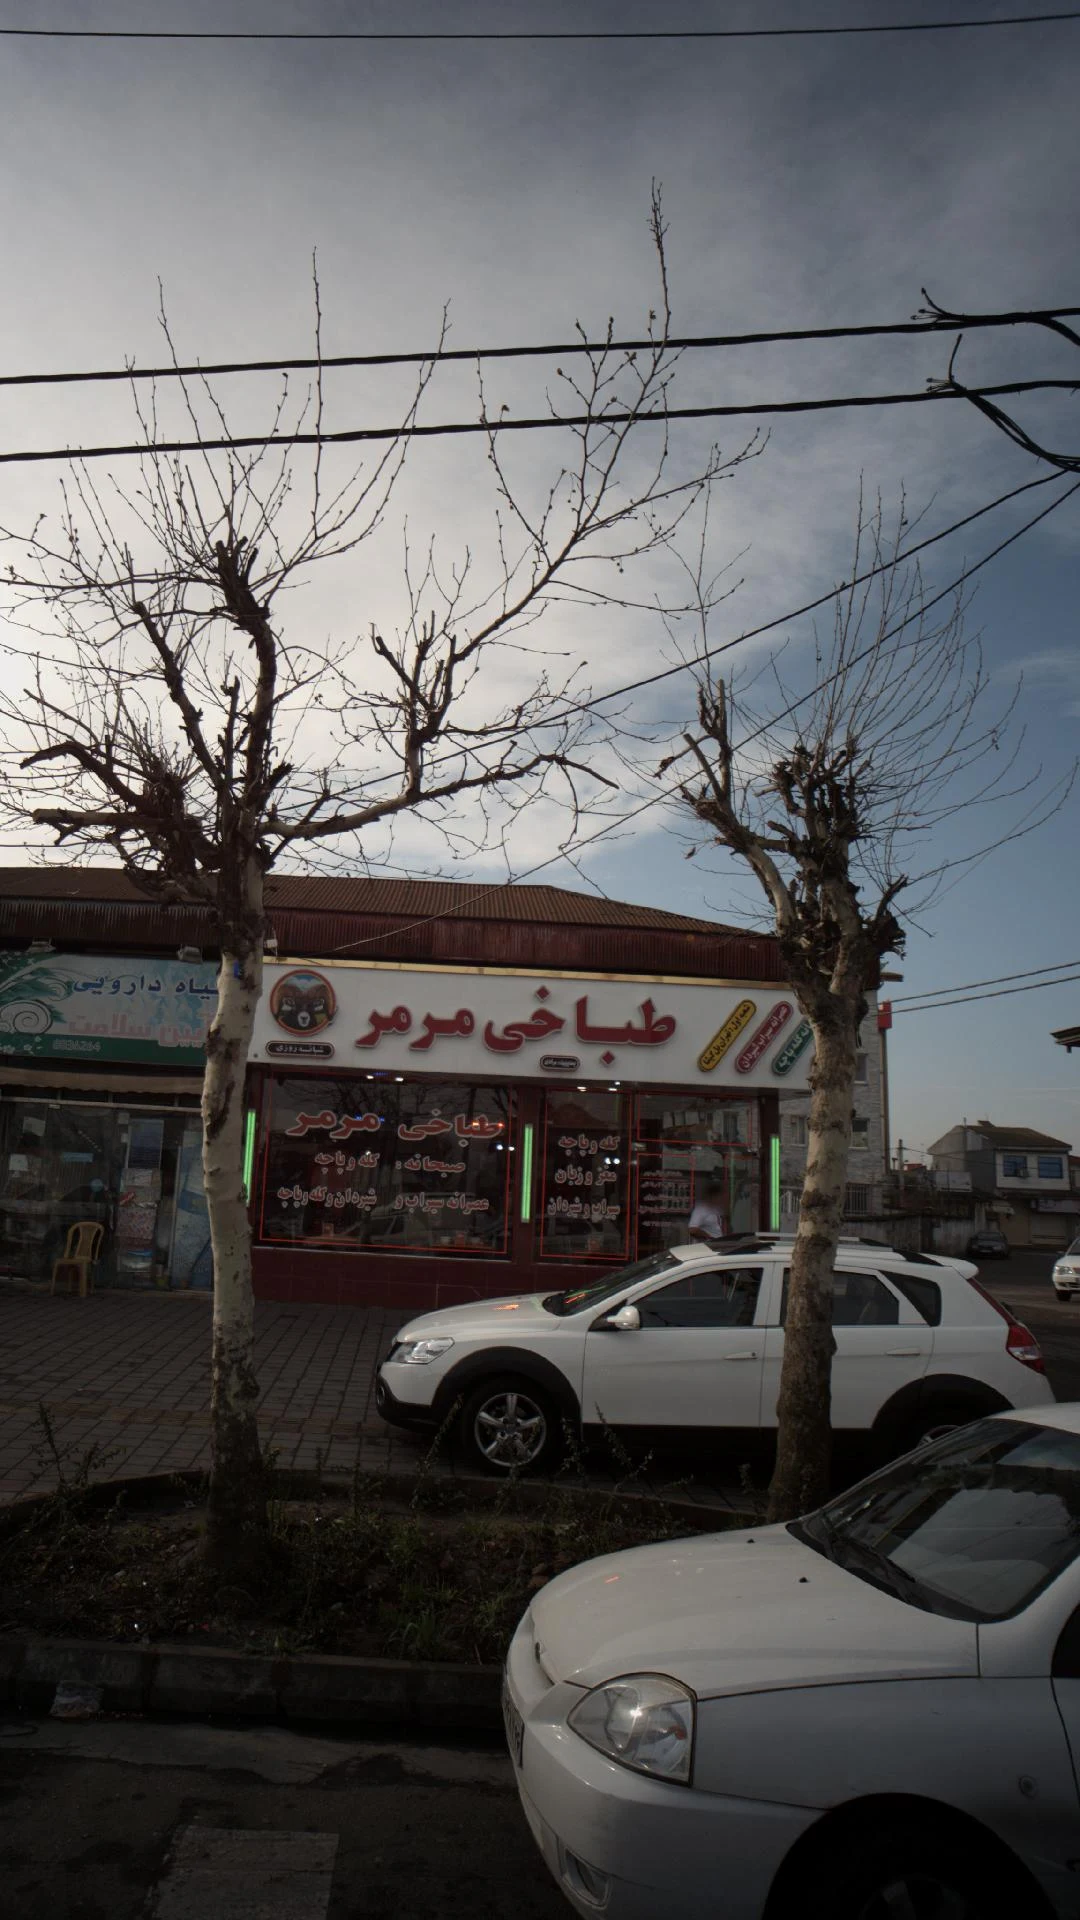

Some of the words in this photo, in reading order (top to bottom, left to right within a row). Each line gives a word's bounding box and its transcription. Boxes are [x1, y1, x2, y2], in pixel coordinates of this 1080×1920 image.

[73, 974, 162, 995] دارویی
[176, 977, 219, 999] یاه
[68, 1012, 152, 1038] سلامت
[355, 1005, 475, 1051] مرمر
[483, 985, 676, 1066] طباخی
[275, 1044, 298, 1054] روزی
[298, 1044, 325, 1053] شبانه
[286, 1111, 380, 1138] مرمر
[398, 1109, 503, 1147] طباخی
[558, 1133, 589, 1157] پاچه
[588, 1140, 598, 1154] و
[599, 1135, 621, 1151] کله
[314, 1150, 346, 1175] پاچه
[346, 1156, 357, 1171] و
[358, 1150, 381, 1169] کله
[554, 1164, 584, 1186] زبان
[584, 1170, 593, 1186] و
[595, 1164, 617, 1186] مغز
[277, 1184, 303, 1208] پاچه
[301, 1190, 309, 1206] و
[309, 1185, 328, 1202] کله
[324, 1193, 334, 1207] و
[334, 1187, 378, 1211] شیردان
[393, 1194, 404, 1210] و
[404, 1191, 445, 1214] سیراب
[446, 1191, 490, 1215] عصرانه
[547, 1196, 582, 1218] شیردان
[583, 1203, 590, 1219] و
[591, 1198, 621, 1221] سیراب
